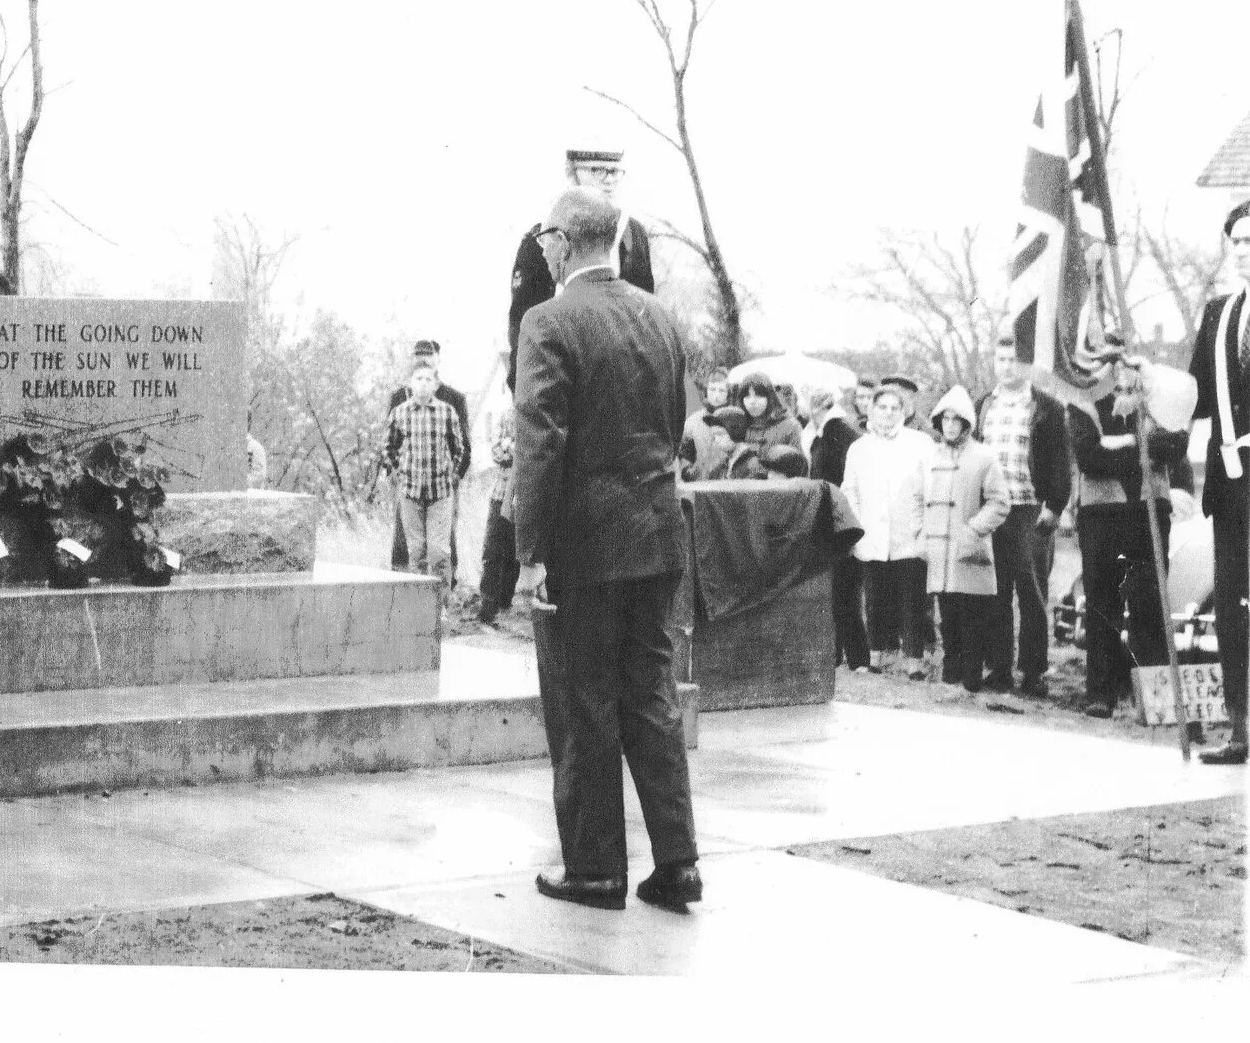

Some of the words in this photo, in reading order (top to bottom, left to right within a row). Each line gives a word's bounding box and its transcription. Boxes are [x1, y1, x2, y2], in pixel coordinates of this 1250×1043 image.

[34, 324, 67, 342] THE
[80, 324, 139, 343] GOING
[152, 325, 203, 344] DOWN
[31, 352, 65, 370] THE
[76, 352, 112, 370] SUN
[126, 352, 150, 370] WE
[162, 352, 202, 371] WILL
[22, 380, 116, 399] REMEMBER
[132, 380, 178, 398] THEM
